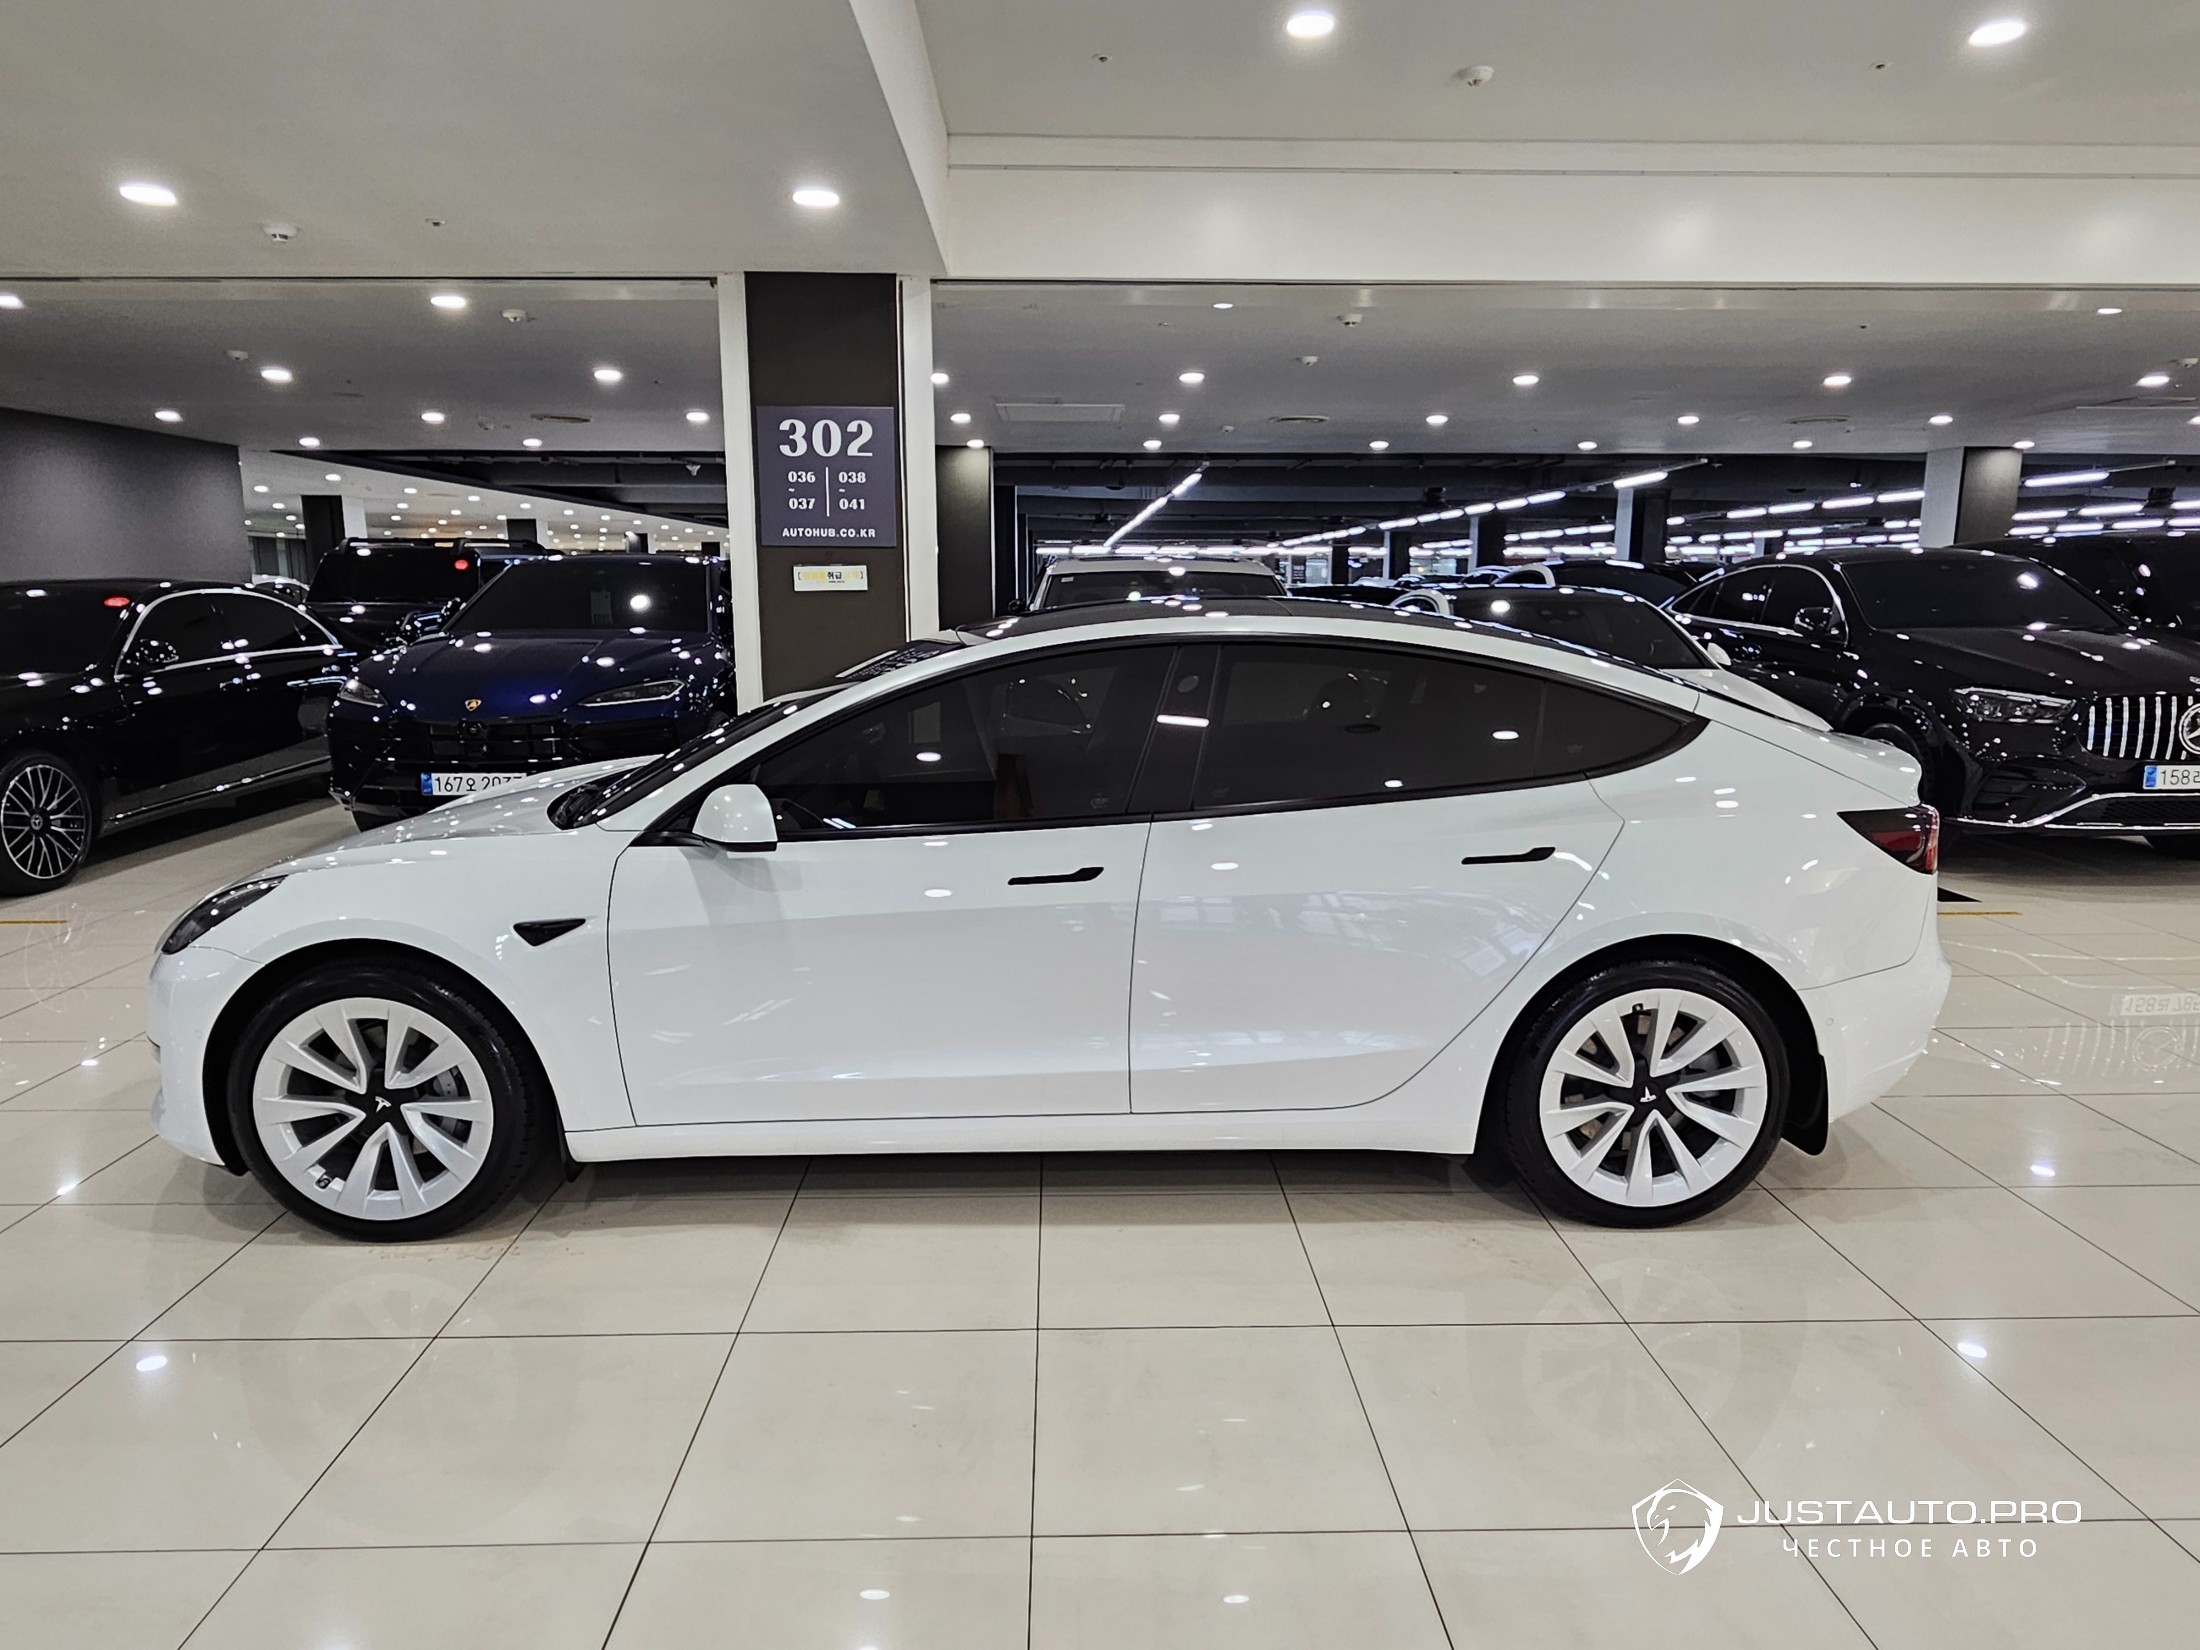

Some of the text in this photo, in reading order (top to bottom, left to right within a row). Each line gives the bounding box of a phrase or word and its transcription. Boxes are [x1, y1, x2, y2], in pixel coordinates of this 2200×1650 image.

[779, 418, 873, 457] 302
[788, 471, 816, 483] 036
[838, 471, 866, 483] 038
[789, 498, 816, 510] 037
[839, 498, 865, 510] 041
[782, 528, 876, 538] AUTOHUB.CO.KR
[434, 776, 477, 792] 167오
